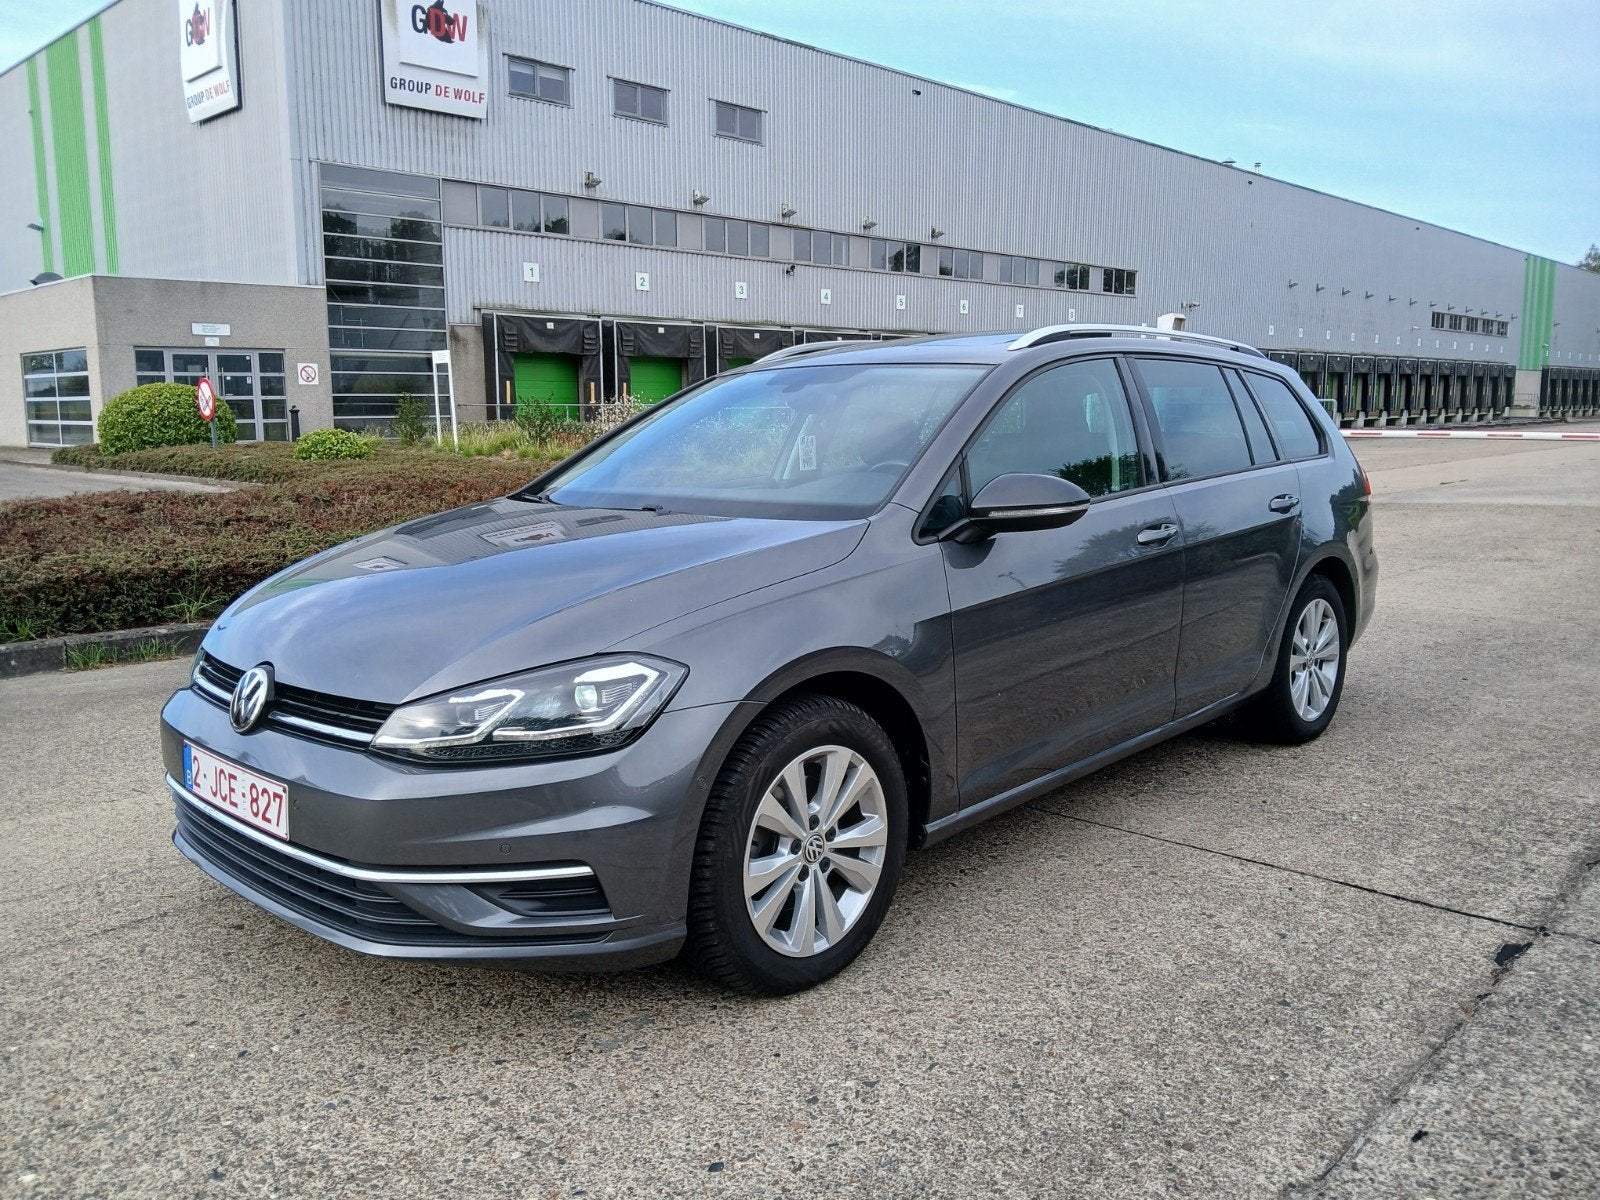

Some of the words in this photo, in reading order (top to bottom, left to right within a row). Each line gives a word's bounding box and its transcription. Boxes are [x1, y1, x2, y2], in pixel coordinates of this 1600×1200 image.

[411, 4, 468, 42] GDW
[186, 91, 205, 109] GROUP
[205, 86, 214, 101] DE
[213, 79, 231, 98] WOLF
[390, 76, 432, 94] GROUP
[435, 84, 450, 98] DE
[453, 87, 485, 104] WOLF
[640, 276, 646, 287] 2
[739, 285, 744, 295] 3
